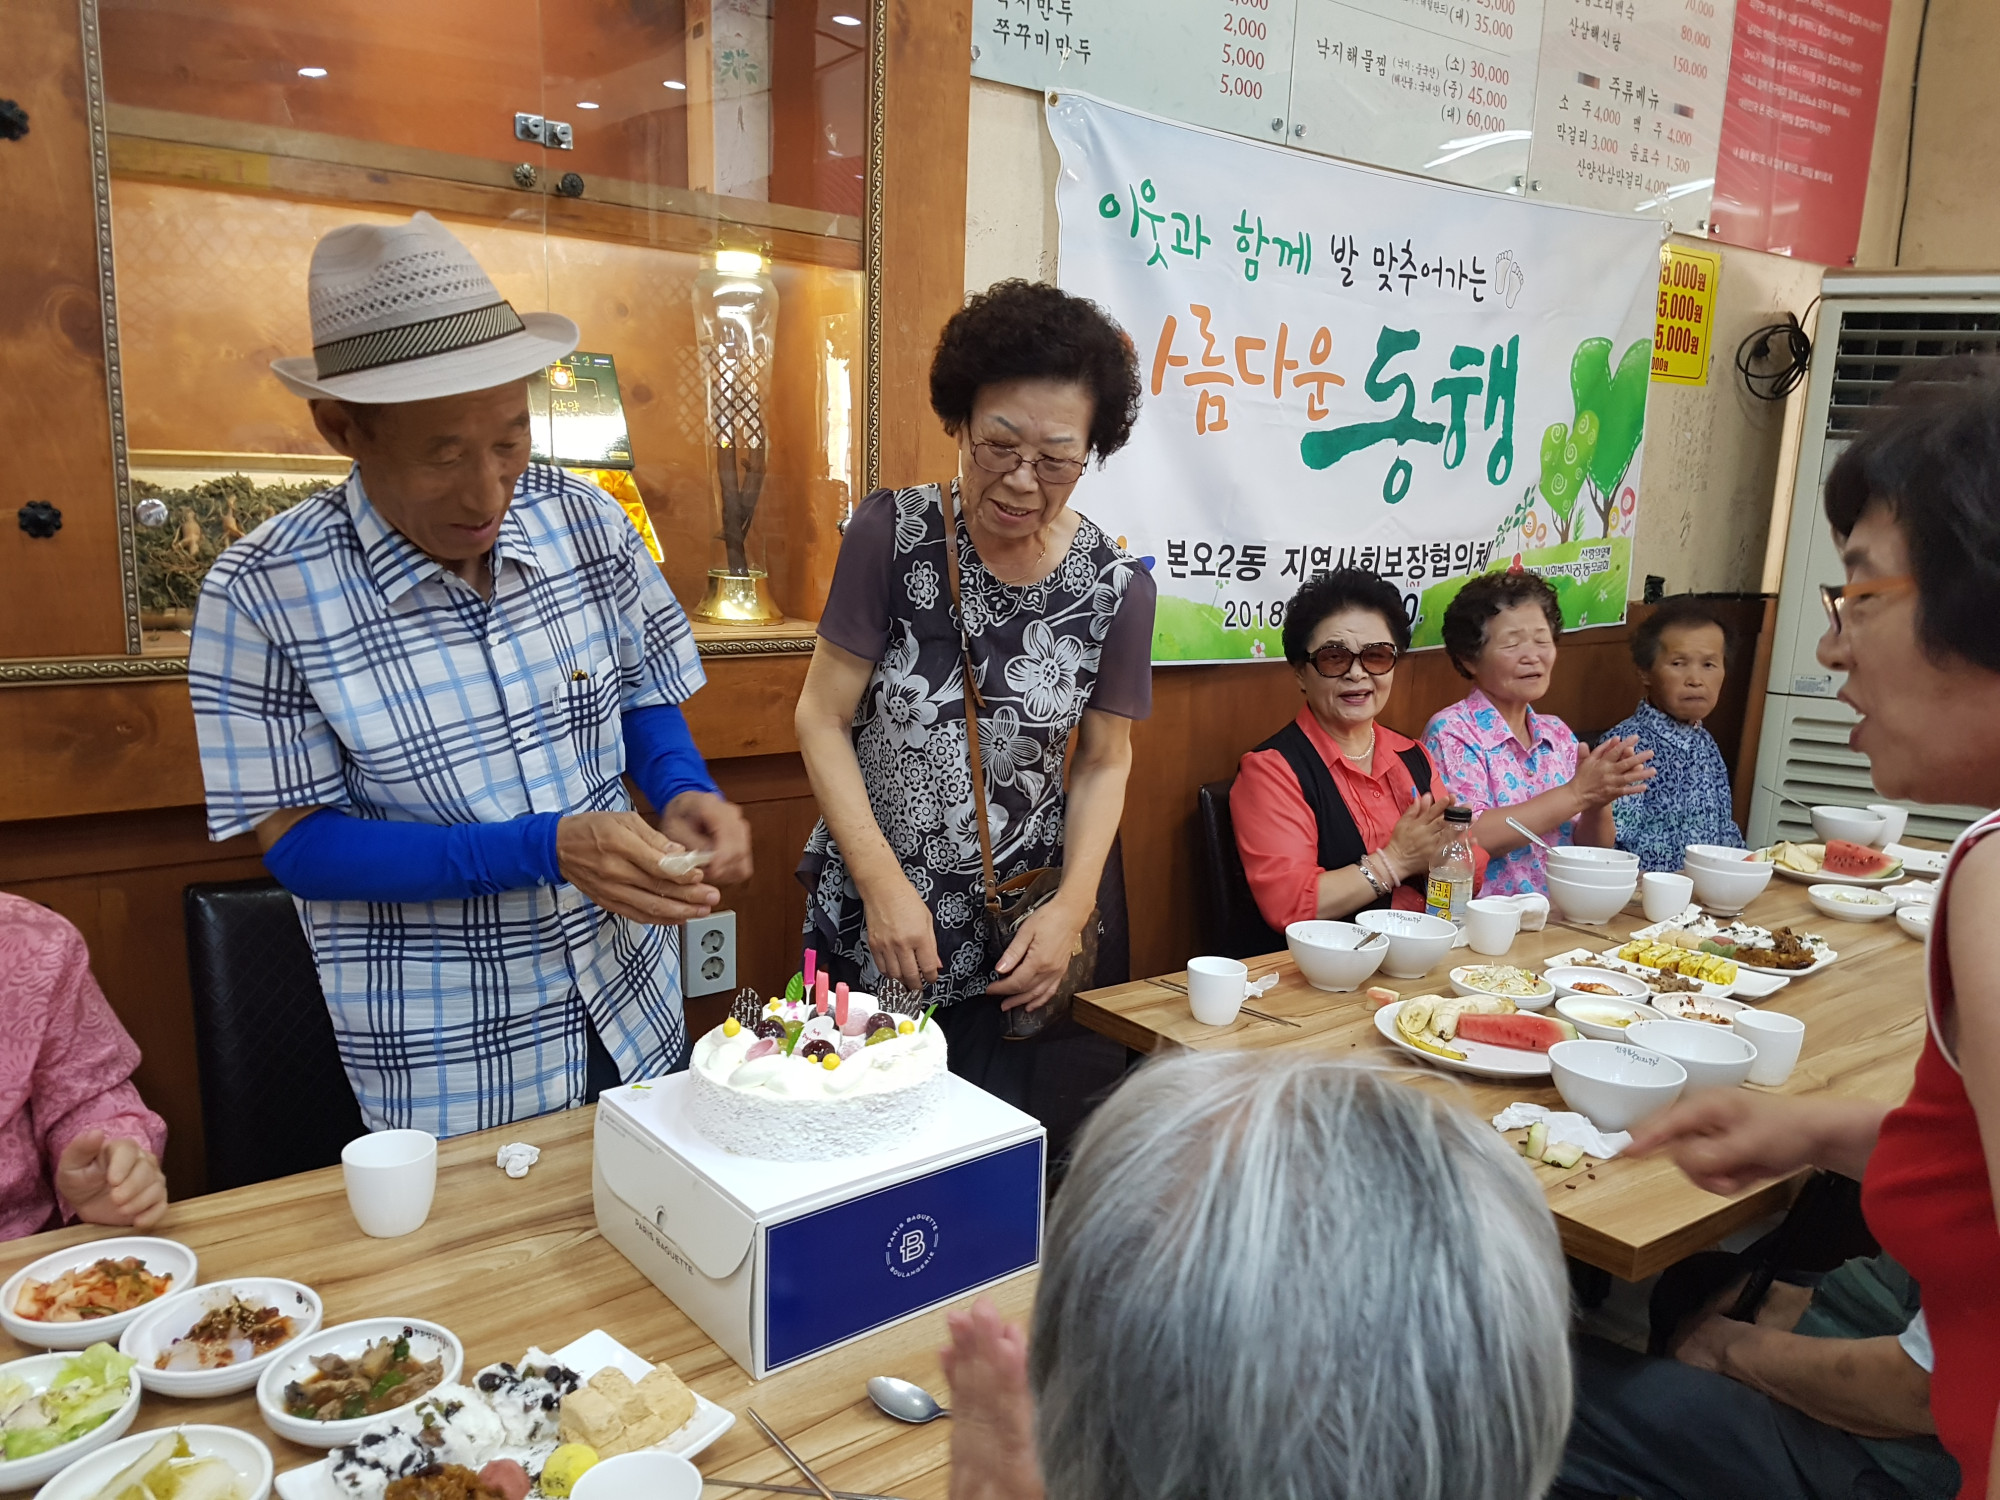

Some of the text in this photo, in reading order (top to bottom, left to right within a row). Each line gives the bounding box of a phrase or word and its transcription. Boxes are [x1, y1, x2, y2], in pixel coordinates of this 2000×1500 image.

[1223, 13, 1267, 40] 2,000
[1450, 6, 1469, 28] (대)
[1474, 13, 1513, 40] 35,000
[1681, 25, 1711, 49] 80,000
[993, 18, 1091, 65] 쭈꾸미만두
[1222, 44, 1265, 71] 5,000
[1317, 37, 1387, 77] 낙지해물찜
[1445, 53, 1465, 75] (소)
[1469, 60, 1509, 86] 30,000
[1673, 55, 1708, 80] 150,000
[1219, 73, 1263, 100] 5,000
[1443, 79, 1463, 100] (중)
[1468, 86, 1508, 110] 45,000
[1608, 77, 1659, 112] 주류메뉴
[1441, 104, 1505, 132] (대) 60,000
[1594, 105, 1621, 126] 4,000
[1667, 128, 1692, 147] 4,000
[1557, 122, 1588, 149] 막걸리
[1591, 134, 1618, 154] 3,000
[1630, 143, 1659, 168] 음료수
[1576, 158, 1643, 192] 산양산삼막걸리
[1099, 178, 1487, 302] 이웃과 함께 발 맞추어가는
[1659, 260, 1707, 292] 5,000원
[1656, 291, 1703, 324] 5,000원
[1300, 325, 1520, 504] 동행
[1166, 539, 1496, 583] 본오2동 지역사회보장협의체
